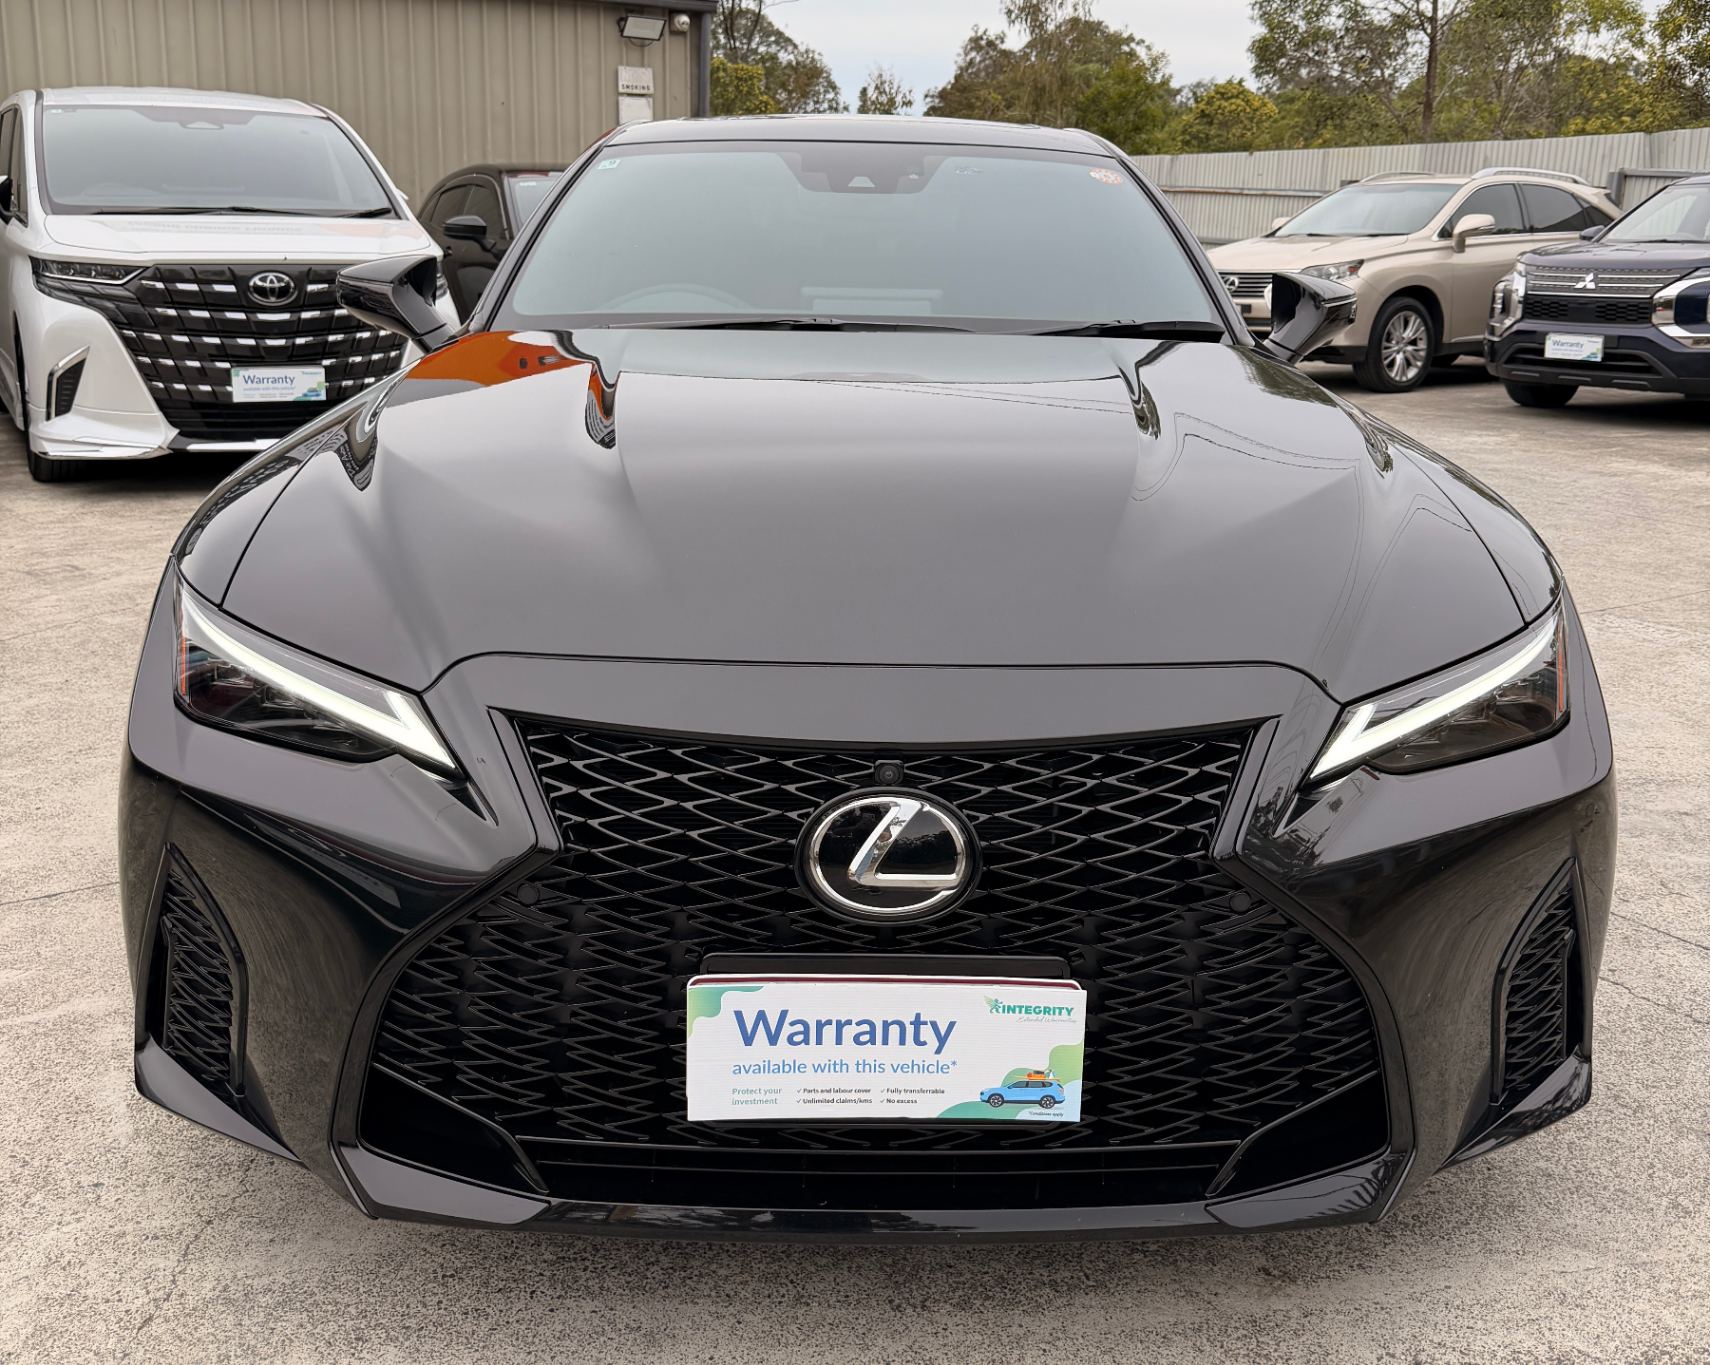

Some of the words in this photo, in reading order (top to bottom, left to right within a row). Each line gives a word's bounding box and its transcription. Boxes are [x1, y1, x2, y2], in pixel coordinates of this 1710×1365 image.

[1552, 339, 1584, 349] Warranty
[243, 374, 296, 386] Warranty
[1001, 1004, 1074, 1016] INTEGRITY
[733, 1009, 957, 1055] Warranty
[732, 1058, 807, 1075] available
[812, 1059, 849, 1074] with
[854, 1059, 886, 1074] this
[732, 1087, 762, 1095] Protect
[763, 1088, 783, 1096] your
[886, 1087, 902, 1095] Fully
[731, 1097, 779, 1105] investment
